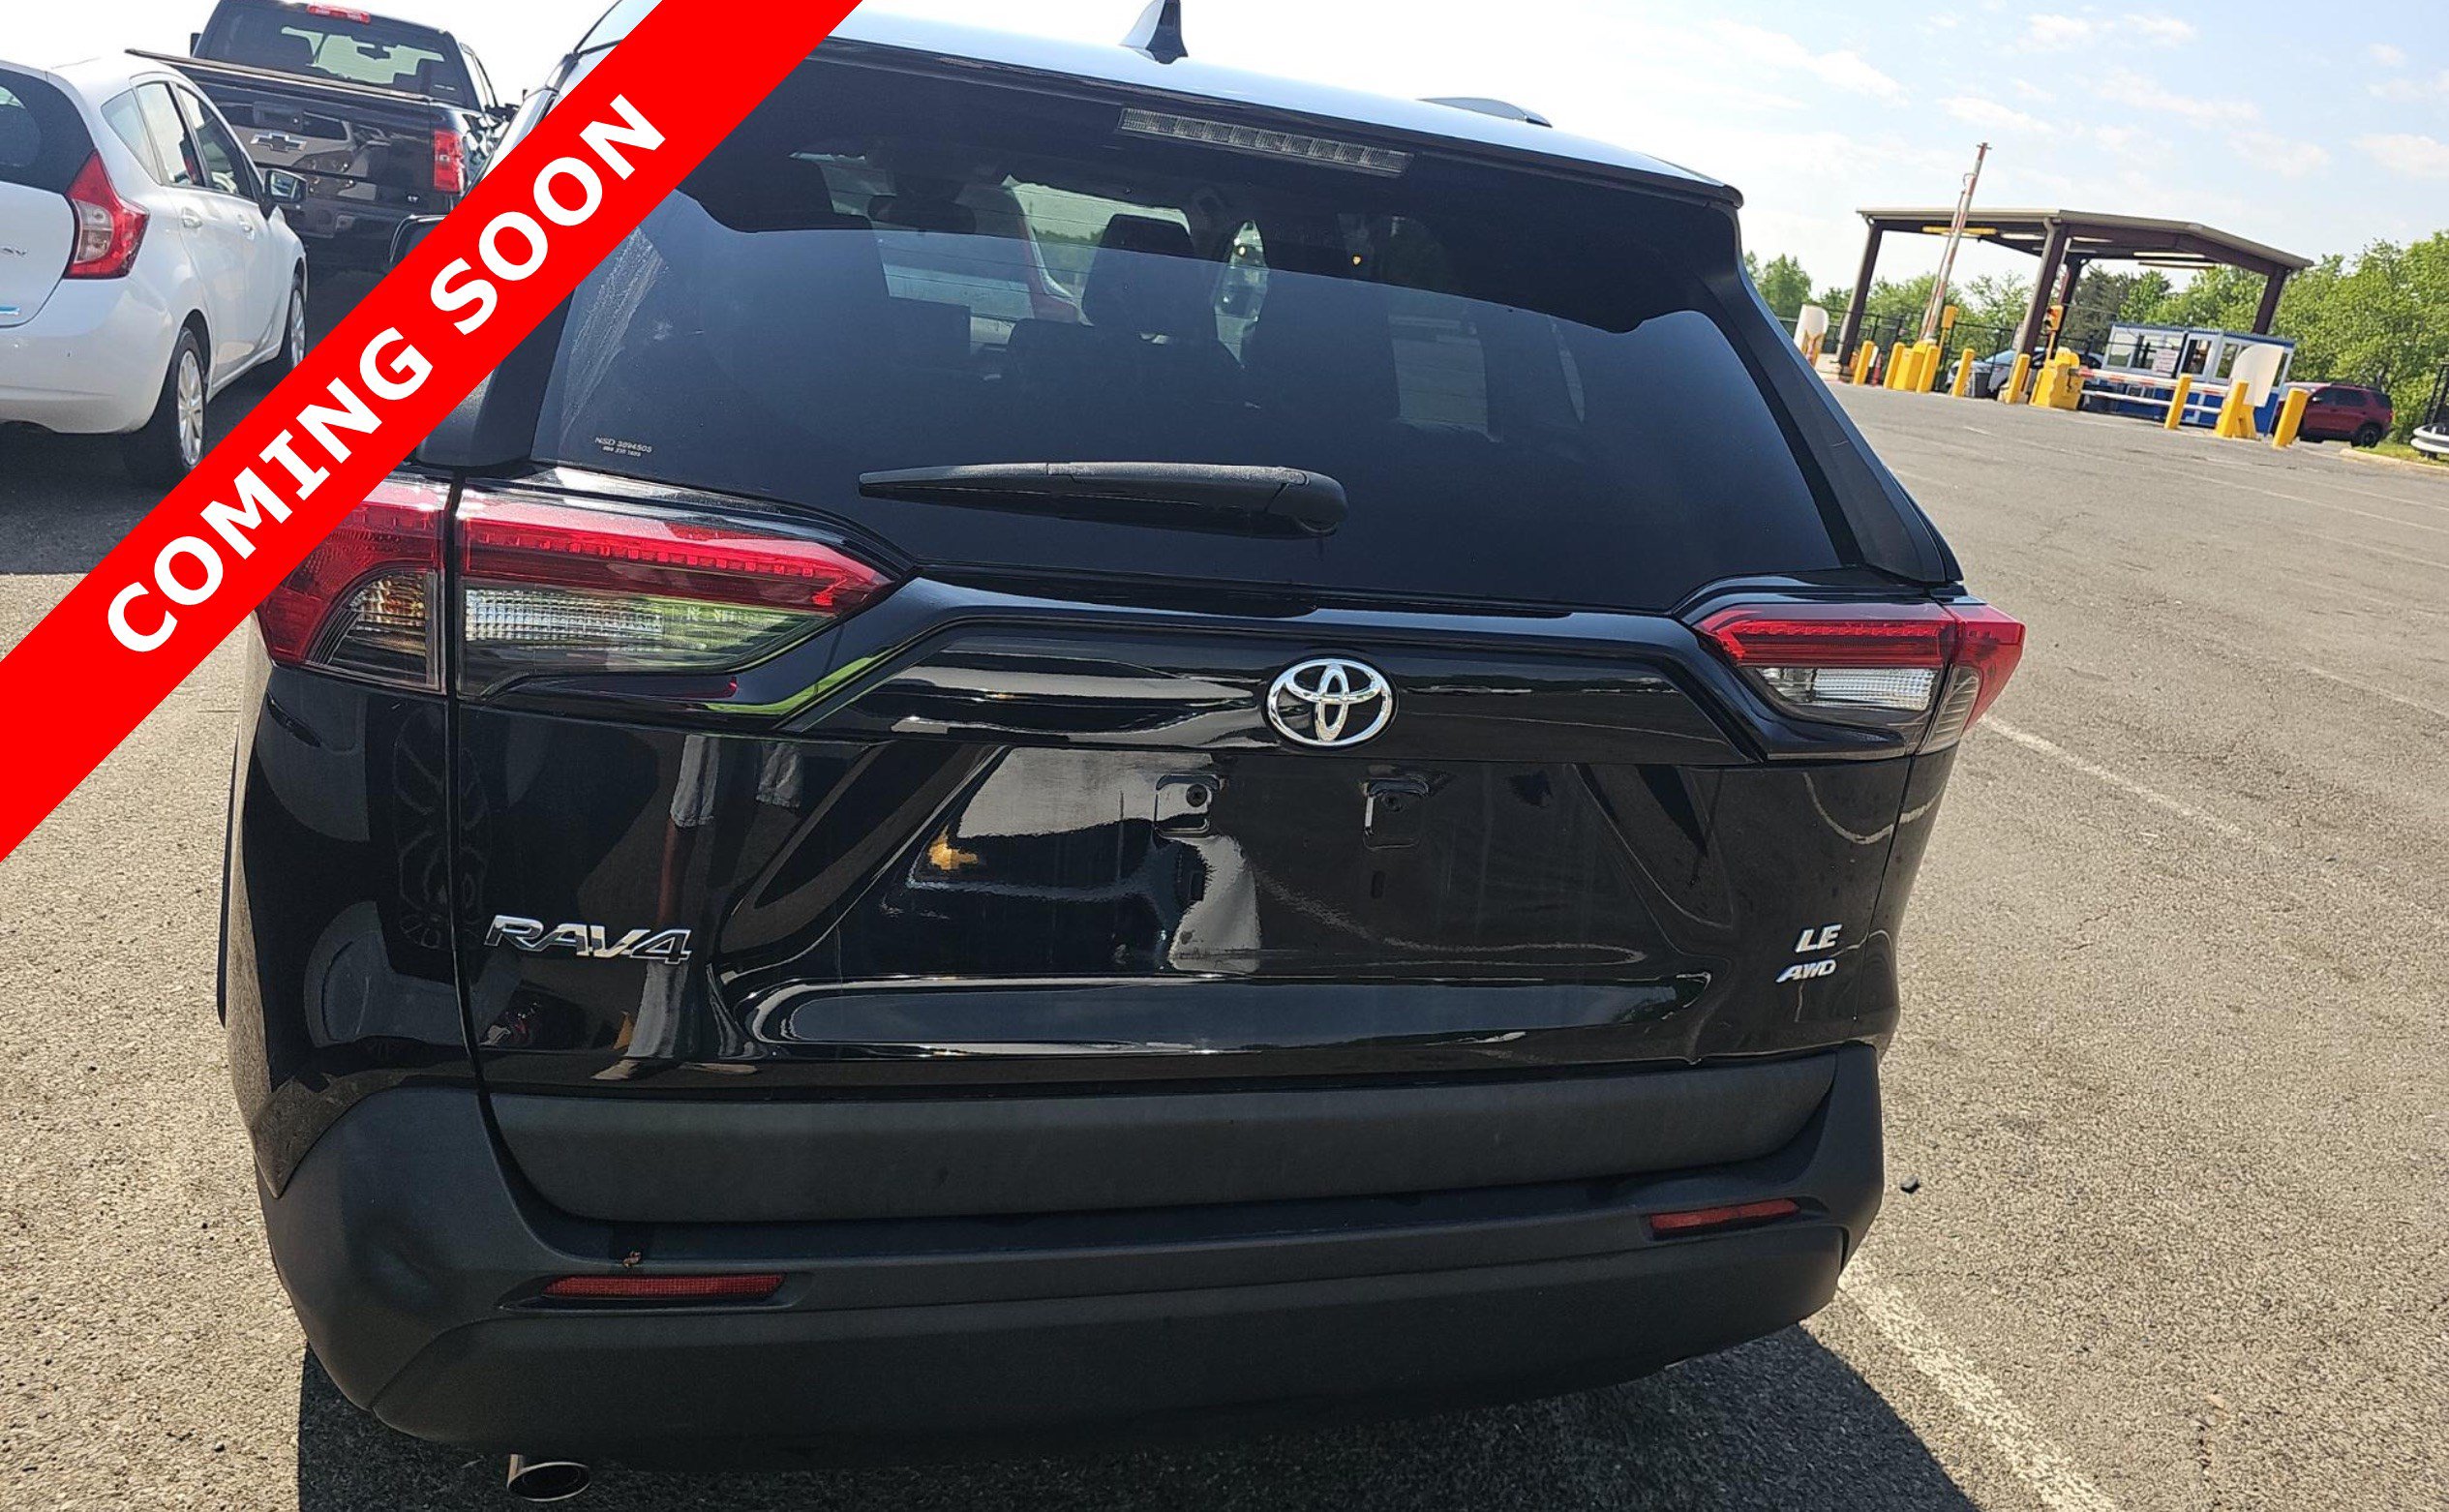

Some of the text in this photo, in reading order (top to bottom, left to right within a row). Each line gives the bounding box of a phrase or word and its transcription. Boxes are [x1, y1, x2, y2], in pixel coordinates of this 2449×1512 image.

[594, 436, 616, 446] NSD
[483, 914, 692, 965] RAV4
[1794, 923, 1843, 953] LE
[1774, 958, 1837, 983] AWD
